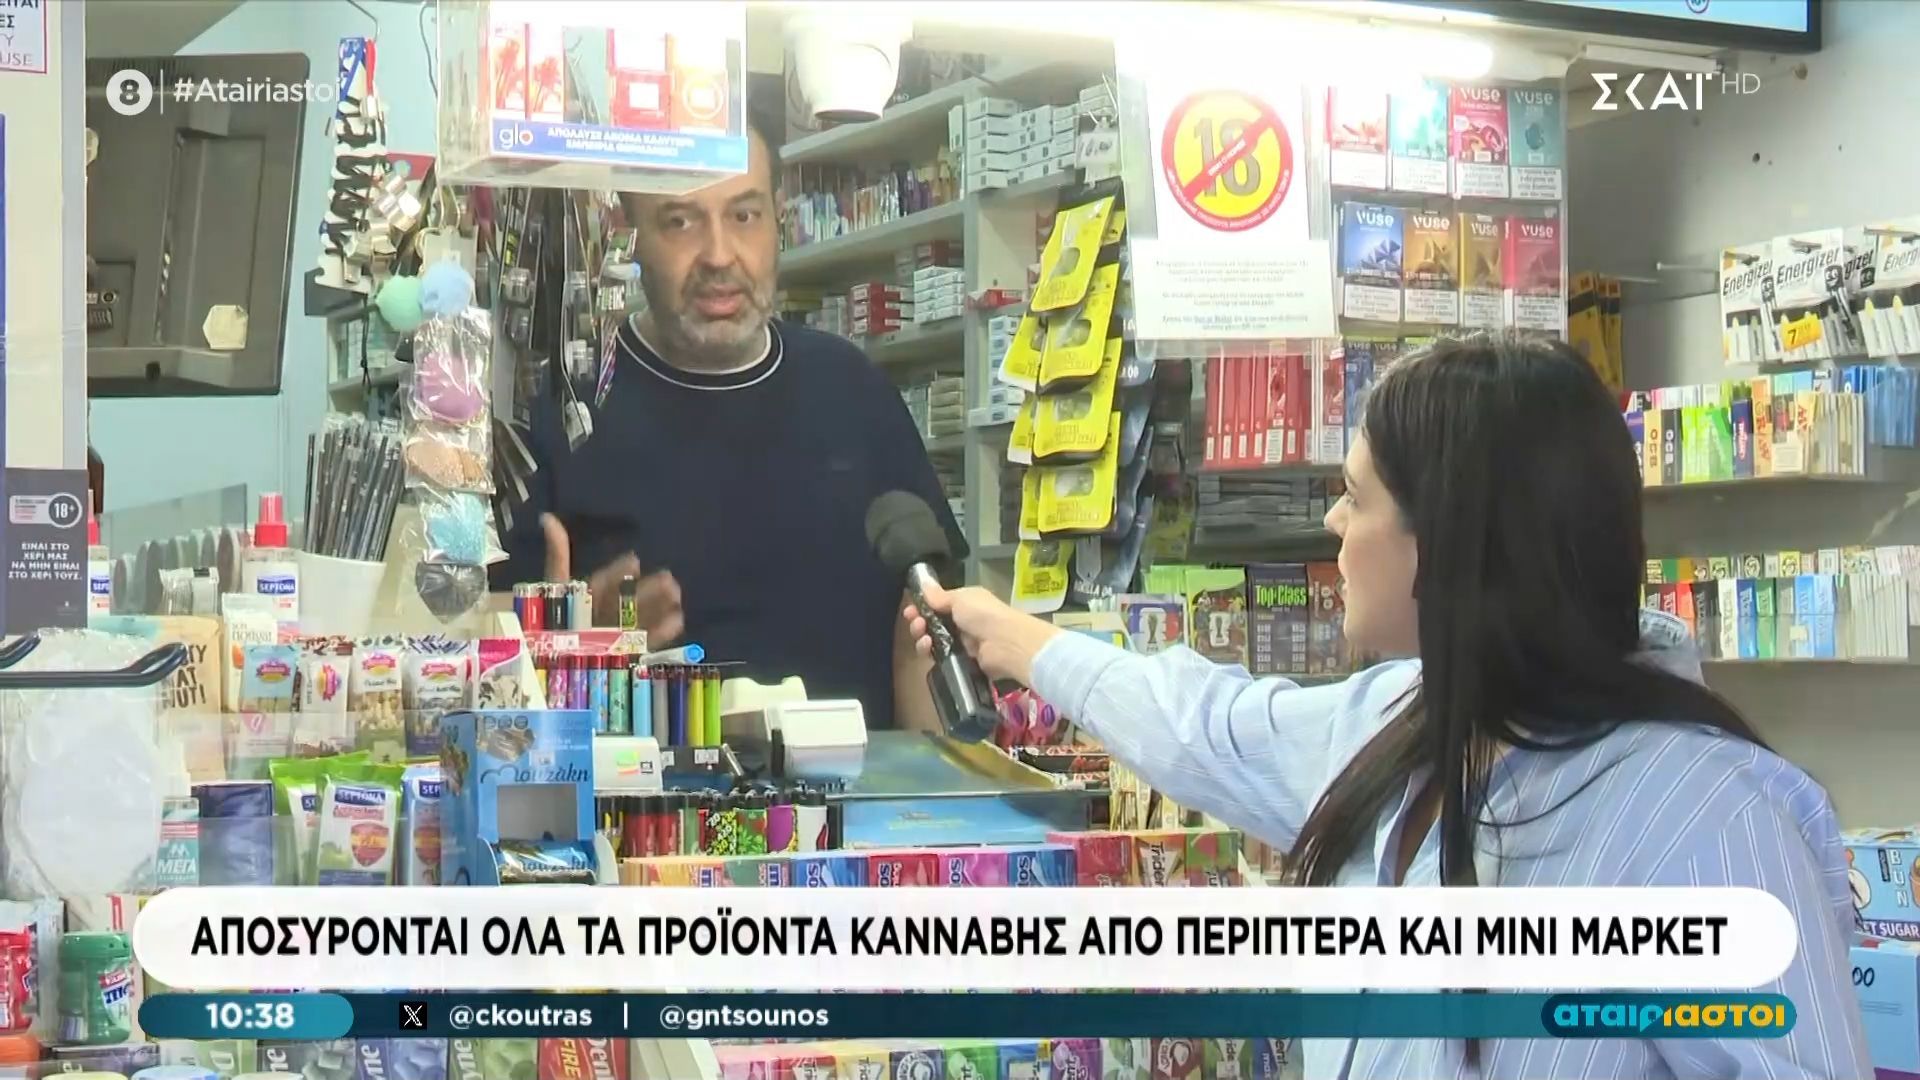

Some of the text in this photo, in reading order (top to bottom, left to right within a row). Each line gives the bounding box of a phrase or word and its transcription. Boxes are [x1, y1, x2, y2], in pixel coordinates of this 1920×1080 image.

[499, 124, 534, 149] glo
[1194, 117, 1261, 197] 18
[1723, 260, 1773, 296] Energizer
[1777, 249, 1839, 284] Energizer
[1650, 428, 1658, 466] OCB
[1665, 429, 1674, 464] OCB
[54, 503, 76, 519] 18+
[11, 561, 80, 570] ΝΑ ΜΗΝ ΕΙΝΑΙ
[24, 552, 68, 560] ΧΕΡΙ ΜΑΣ
[31, 571, 52, 579] ΧΕΡΙ
[259, 582, 295, 592] SEPTONA
[1880, 922, 1919, 938] SUGAR
[561, 1038, 580, 1077] FIRE
